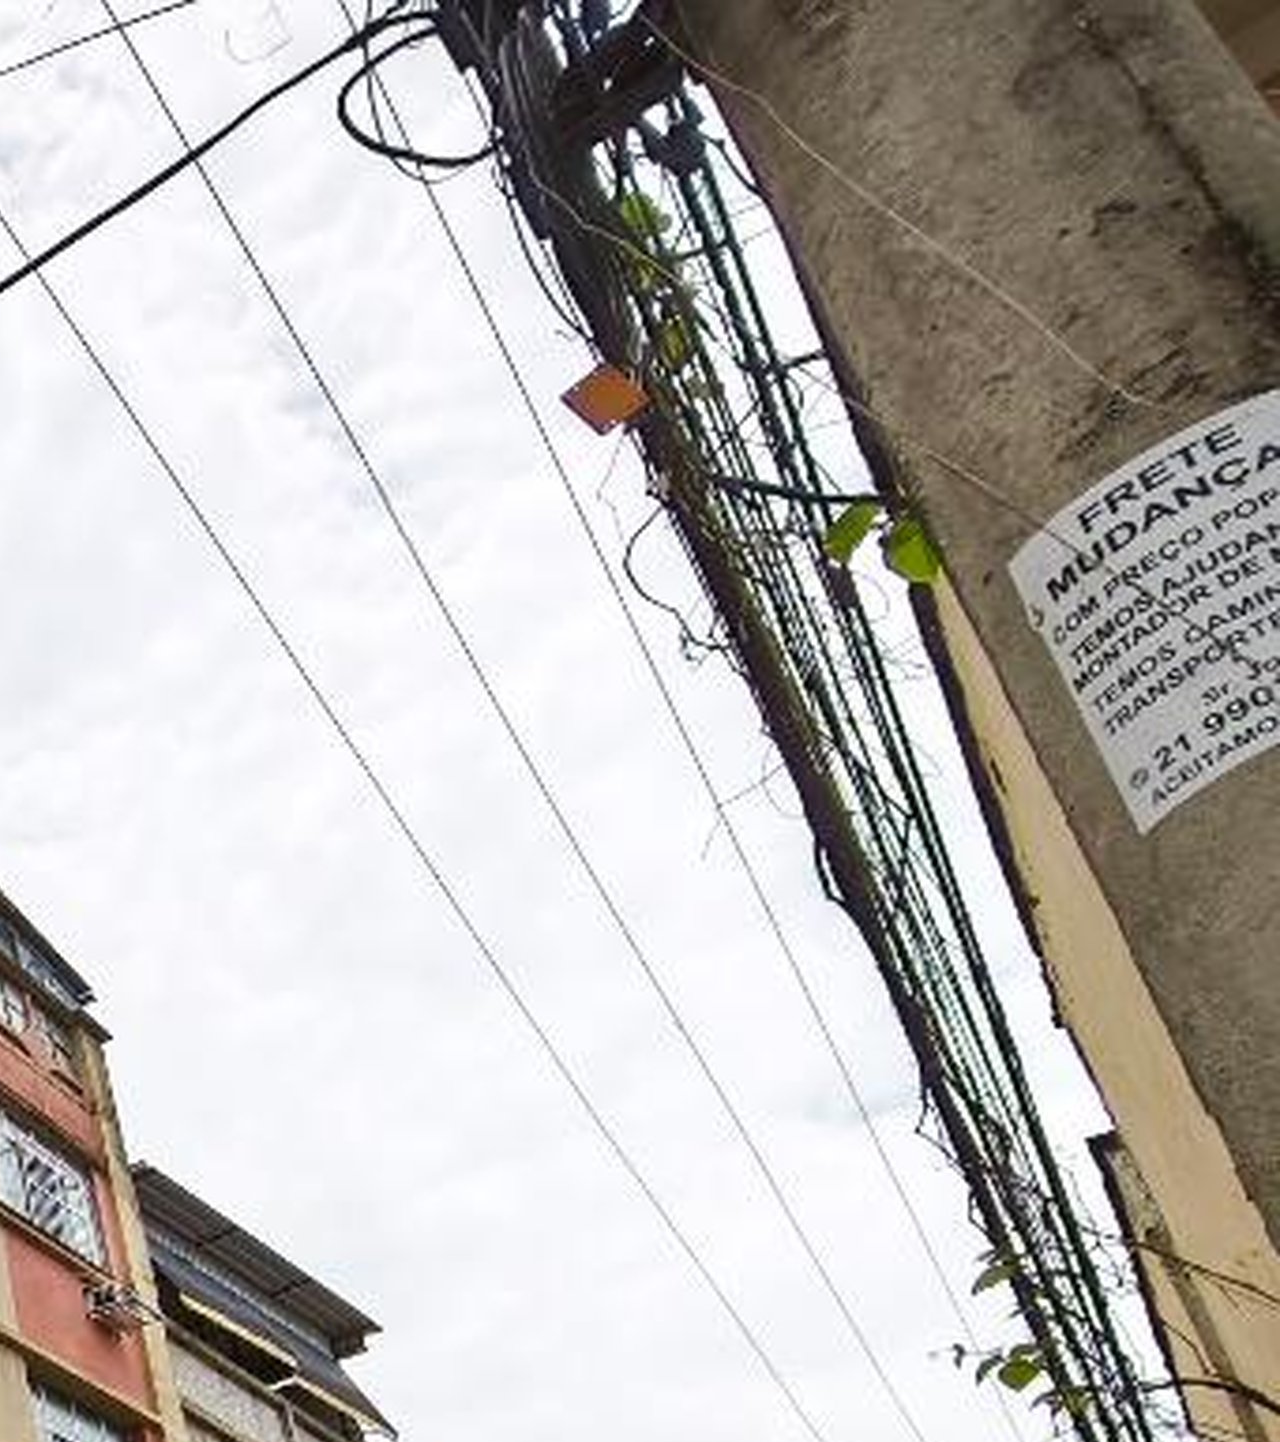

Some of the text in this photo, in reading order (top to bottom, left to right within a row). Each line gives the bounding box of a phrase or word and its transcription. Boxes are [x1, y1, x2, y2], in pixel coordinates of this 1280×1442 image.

[1046, 443, 1280, 602] MUDANÇA
[1078, 423, 1242, 533] FRETE
[1054, 596, 1100, 644] COM
[1071, 595, 1154, 664] TEMOS
[1073, 554, 1265, 694] MONTADOR DE
[1094, 640, 1176, 712] TEMOS
[1153, 677, 1280, 772] 21 990
